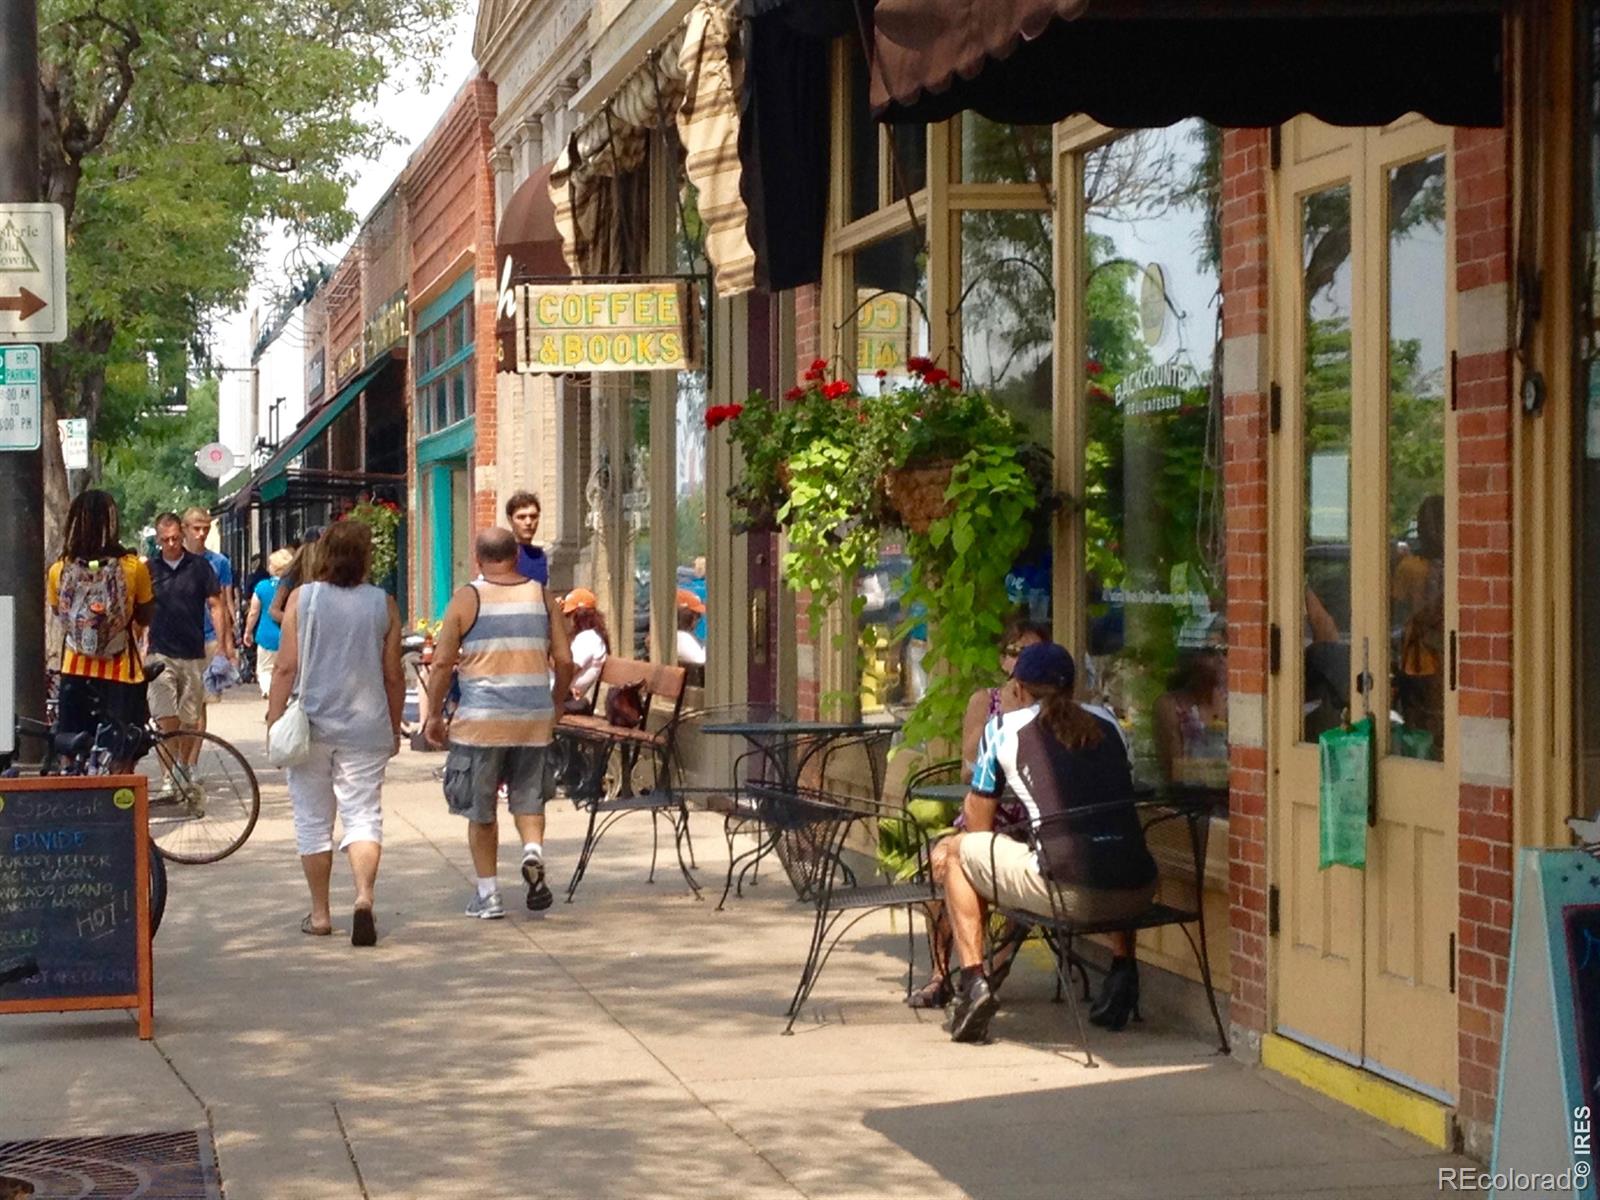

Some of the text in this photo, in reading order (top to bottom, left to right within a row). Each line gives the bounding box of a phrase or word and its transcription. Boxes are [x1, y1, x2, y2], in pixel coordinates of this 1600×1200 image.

[536, 291, 678, 325] COFFEE
[16, 352, 28, 364] HR
[21, 417, 32, 429] PM
